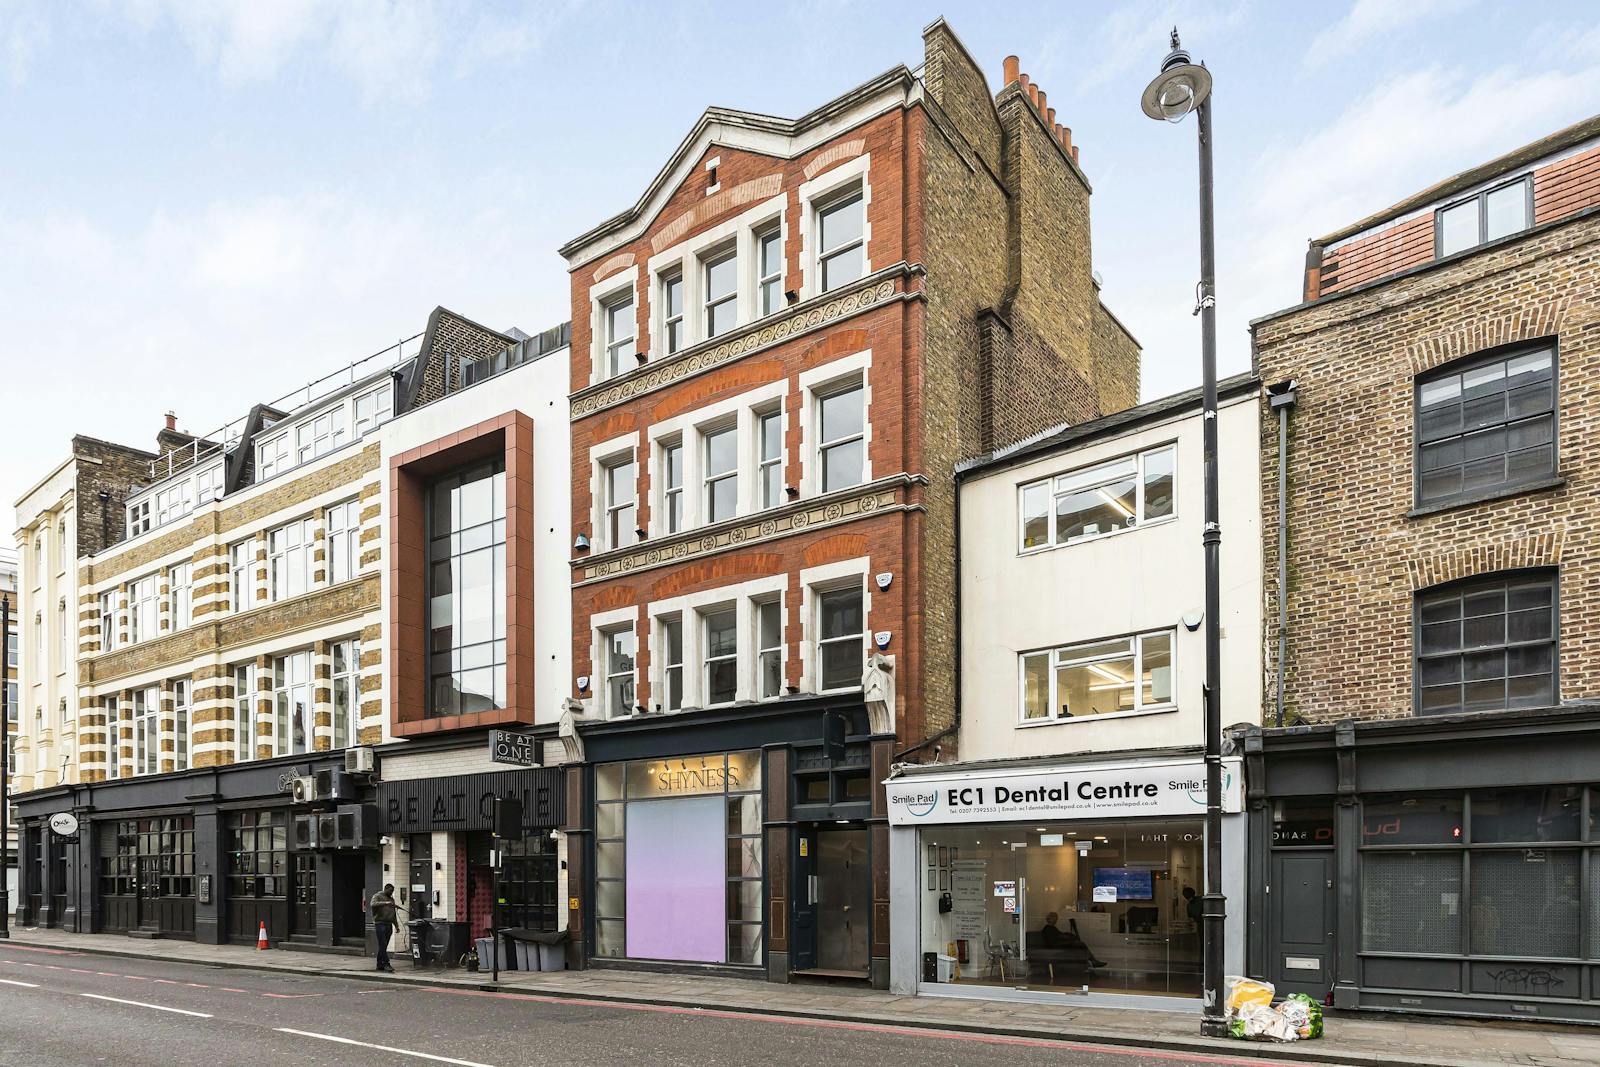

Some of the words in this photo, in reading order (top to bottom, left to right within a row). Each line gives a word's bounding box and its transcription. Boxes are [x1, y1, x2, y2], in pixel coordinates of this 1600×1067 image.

[497, 731, 510, 743] BE
[517, 735, 531, 746] AT
[497, 743, 531, 761] ONE
[1168, 780, 1199, 790] Smile
[892, 795, 915, 804] Smile
[948, 787, 983, 806] EC1
[994, 781, 1069, 804] Dental
[1077, 781, 1158, 800] Centre
[388, 798, 418, 823] BE
[432, 794, 466, 822] AT
